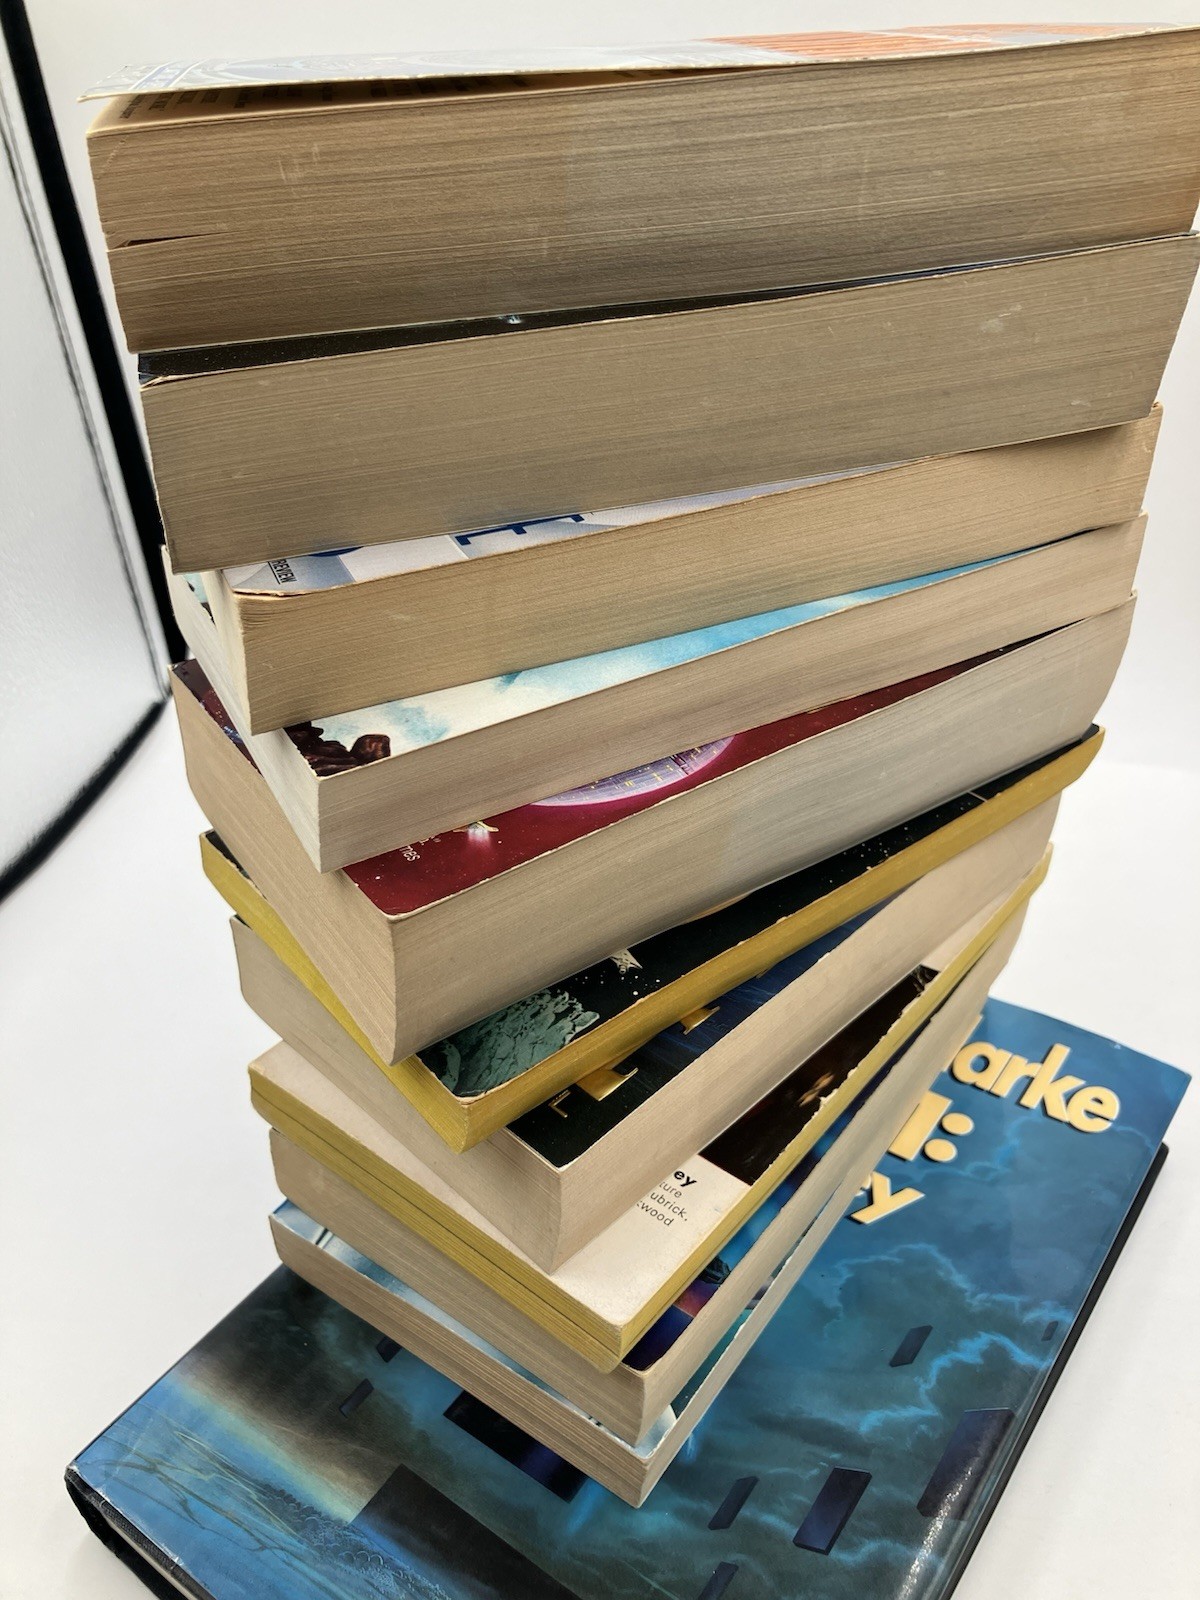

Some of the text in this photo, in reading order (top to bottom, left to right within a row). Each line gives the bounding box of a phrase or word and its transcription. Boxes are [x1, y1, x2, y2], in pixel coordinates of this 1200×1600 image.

[950, 1041, 1121, 1134] arke
[673, 1170, 698, 1187] ey
[850, 1170, 926, 1225] y
[636, 1200, 675, 1226] wood
